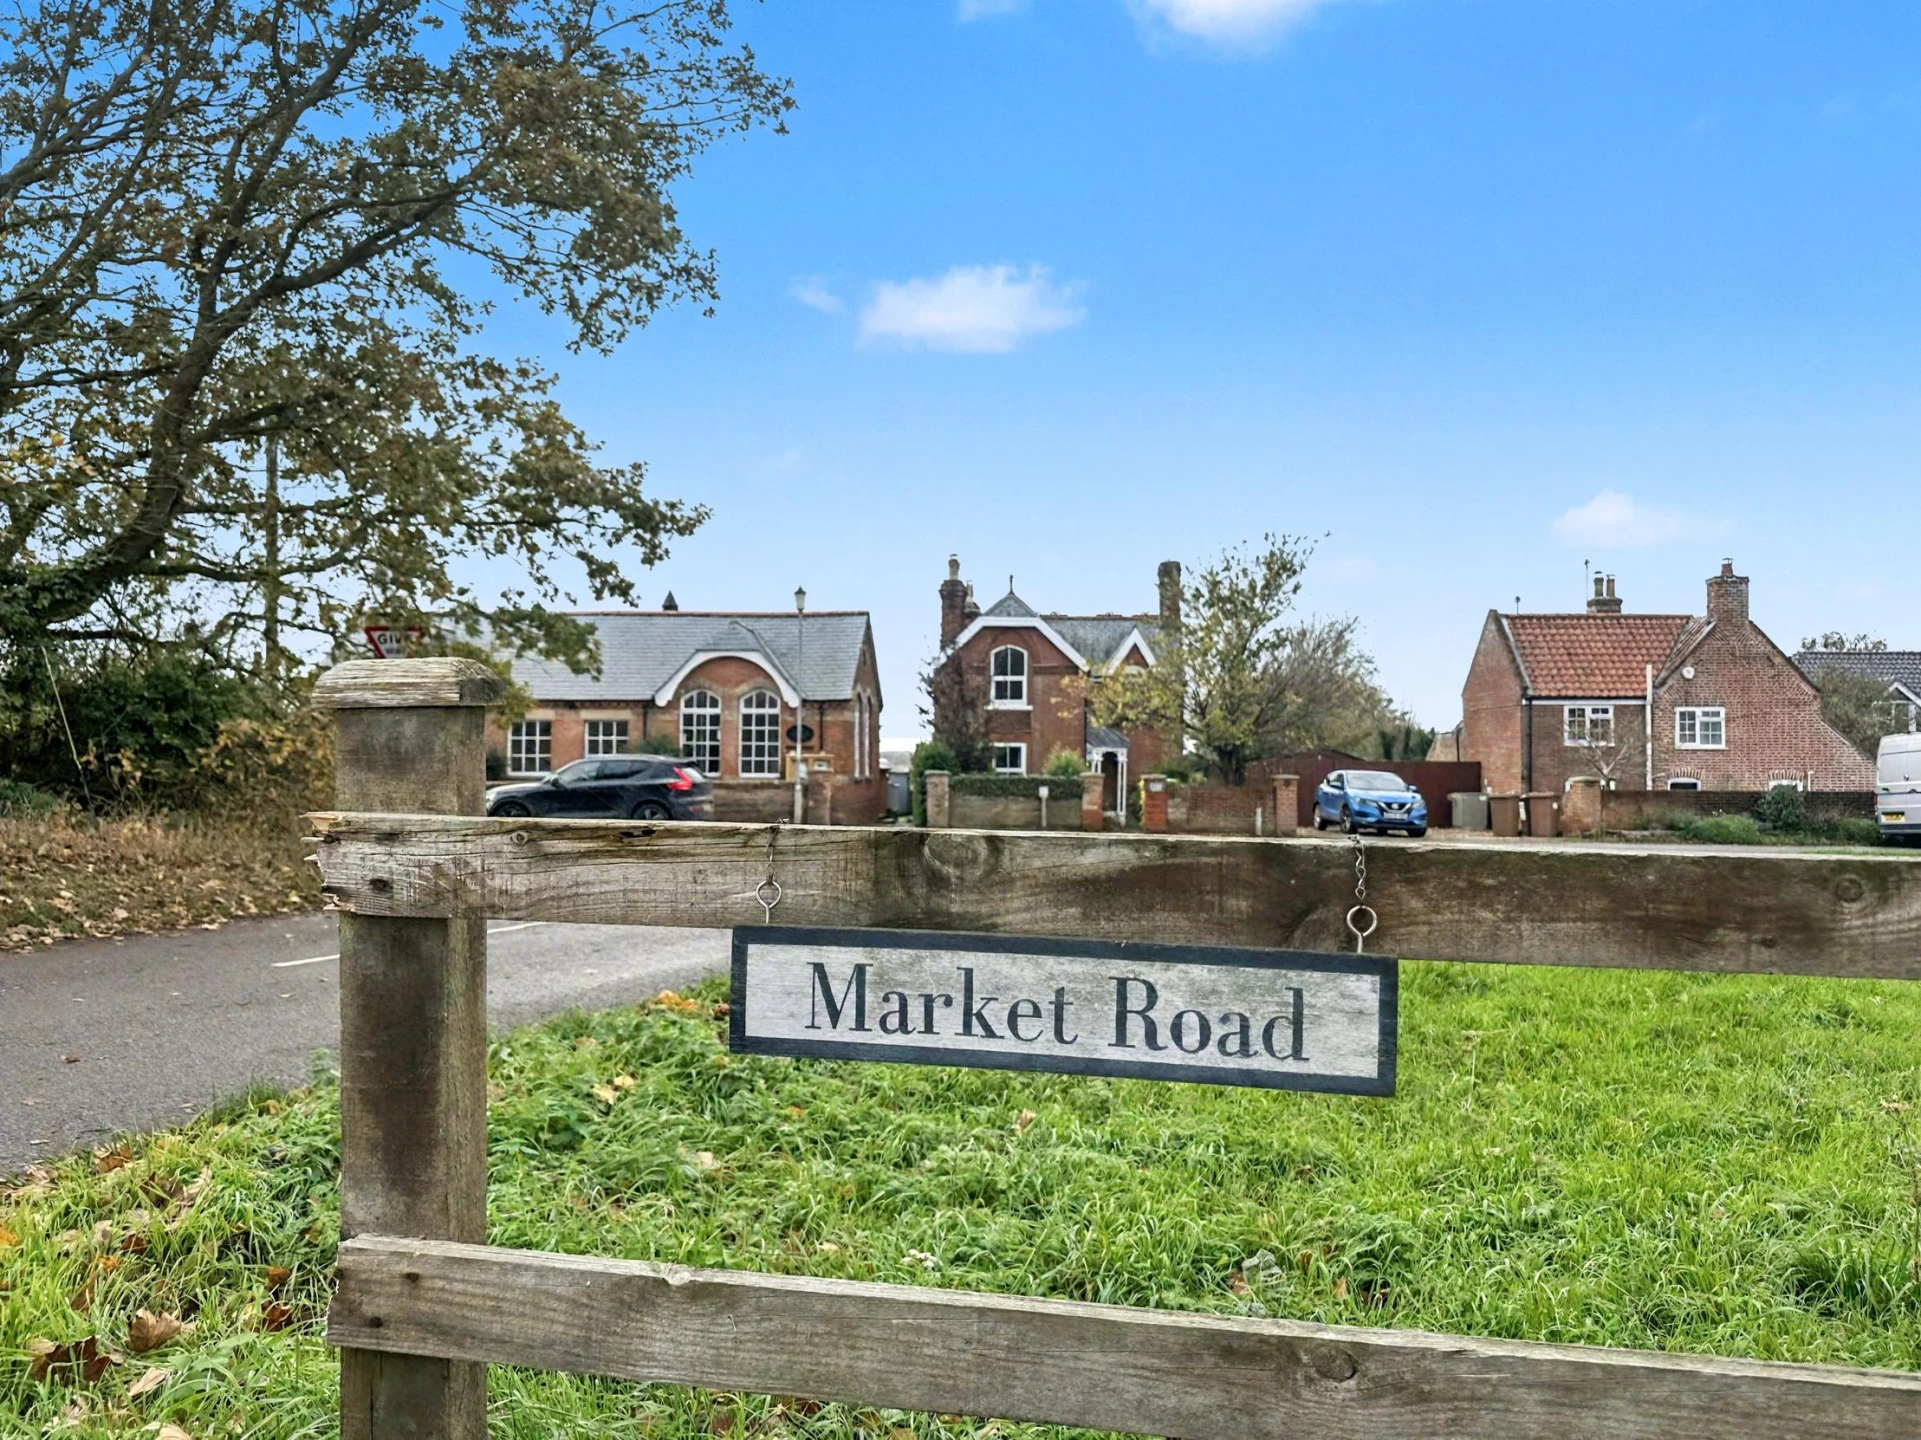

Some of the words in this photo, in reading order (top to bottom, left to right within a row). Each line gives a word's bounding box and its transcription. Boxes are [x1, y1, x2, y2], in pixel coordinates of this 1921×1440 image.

[377, 633, 410, 645] GIV
[804, 962, 1078, 1045] Market
[1107, 976, 1310, 1061] Road
